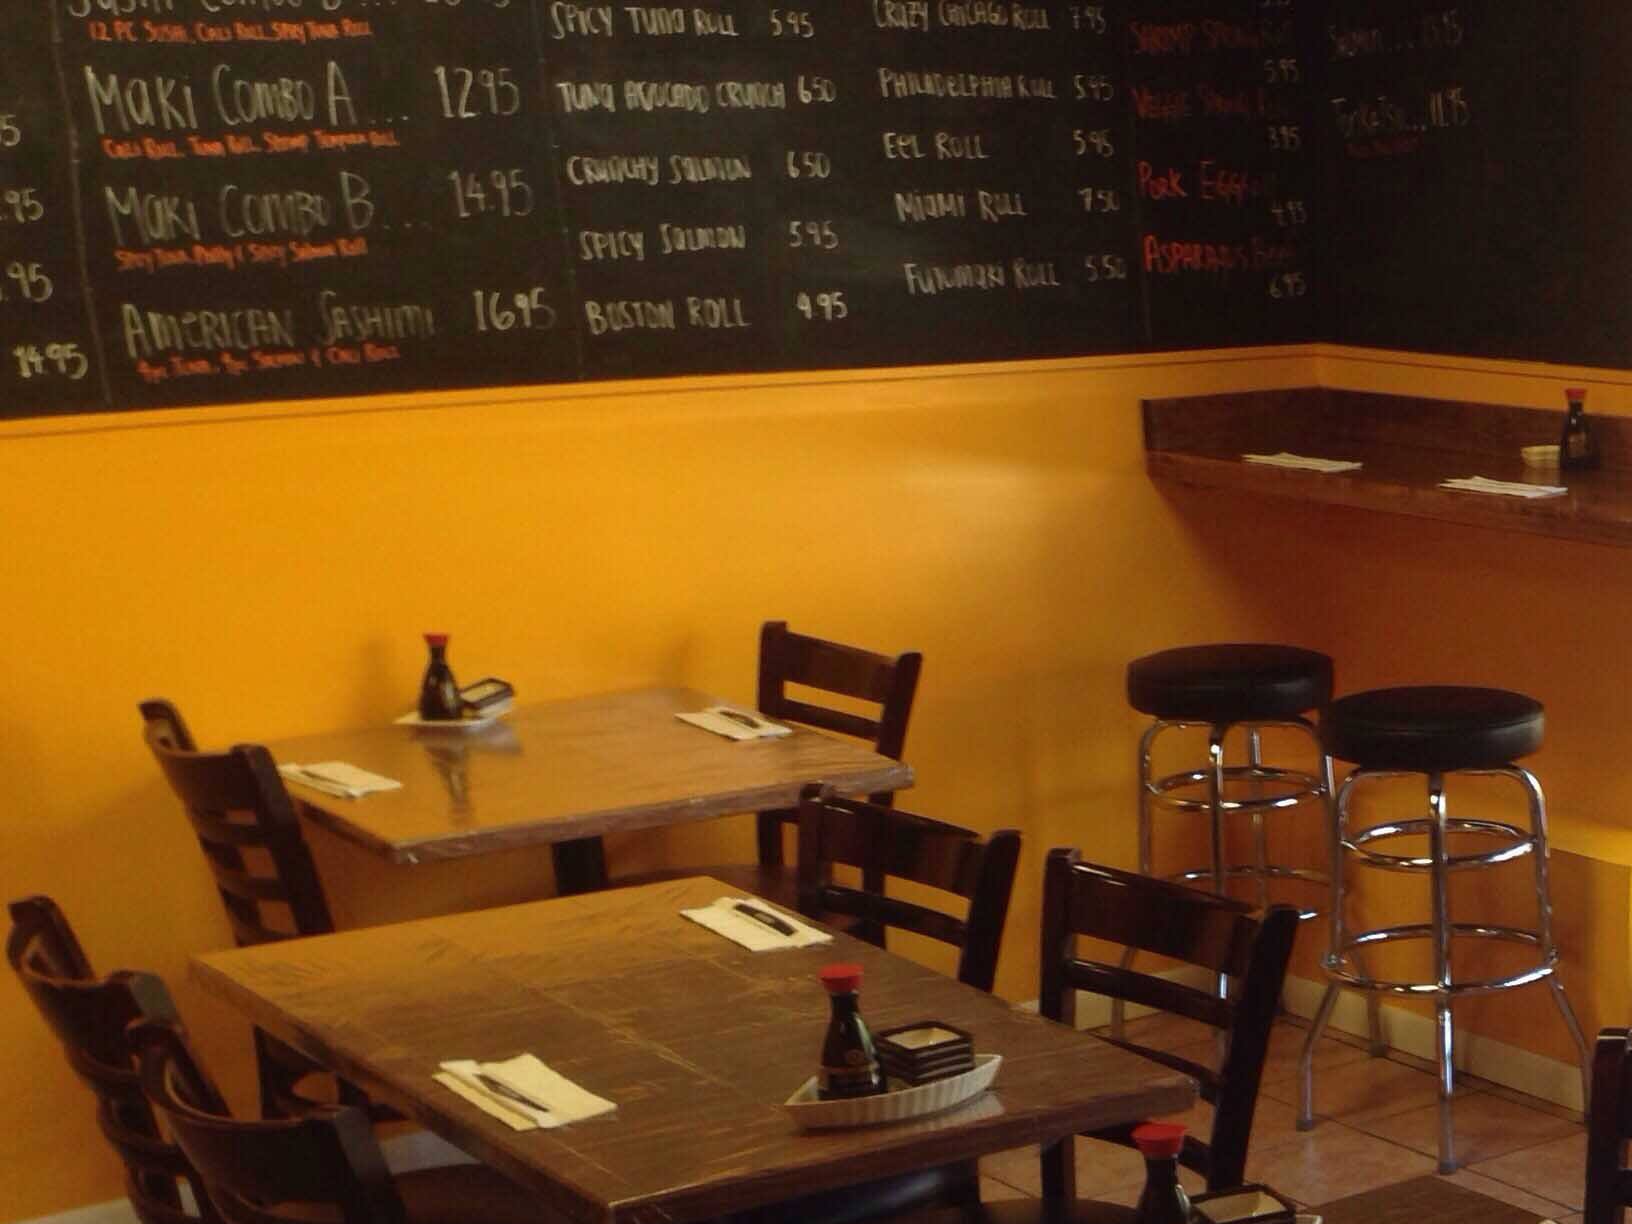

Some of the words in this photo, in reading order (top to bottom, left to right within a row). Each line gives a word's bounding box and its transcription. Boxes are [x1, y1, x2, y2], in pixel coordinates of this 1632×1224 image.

[551, 1, 614, 40] SPICY
[693, 8, 741, 37] ROLL
[326, 60, 358, 126] A
[934, 130, 992, 161] ROLL
[567, 154, 660, 187] CRUNCHY
[340, 171, 375, 231] B
[977, 188, 1031, 223] ROLL
[579, 231, 645, 262] SPICY
[585, 299, 676, 337] BOSTON
[686, 296, 753, 330] ROLL
